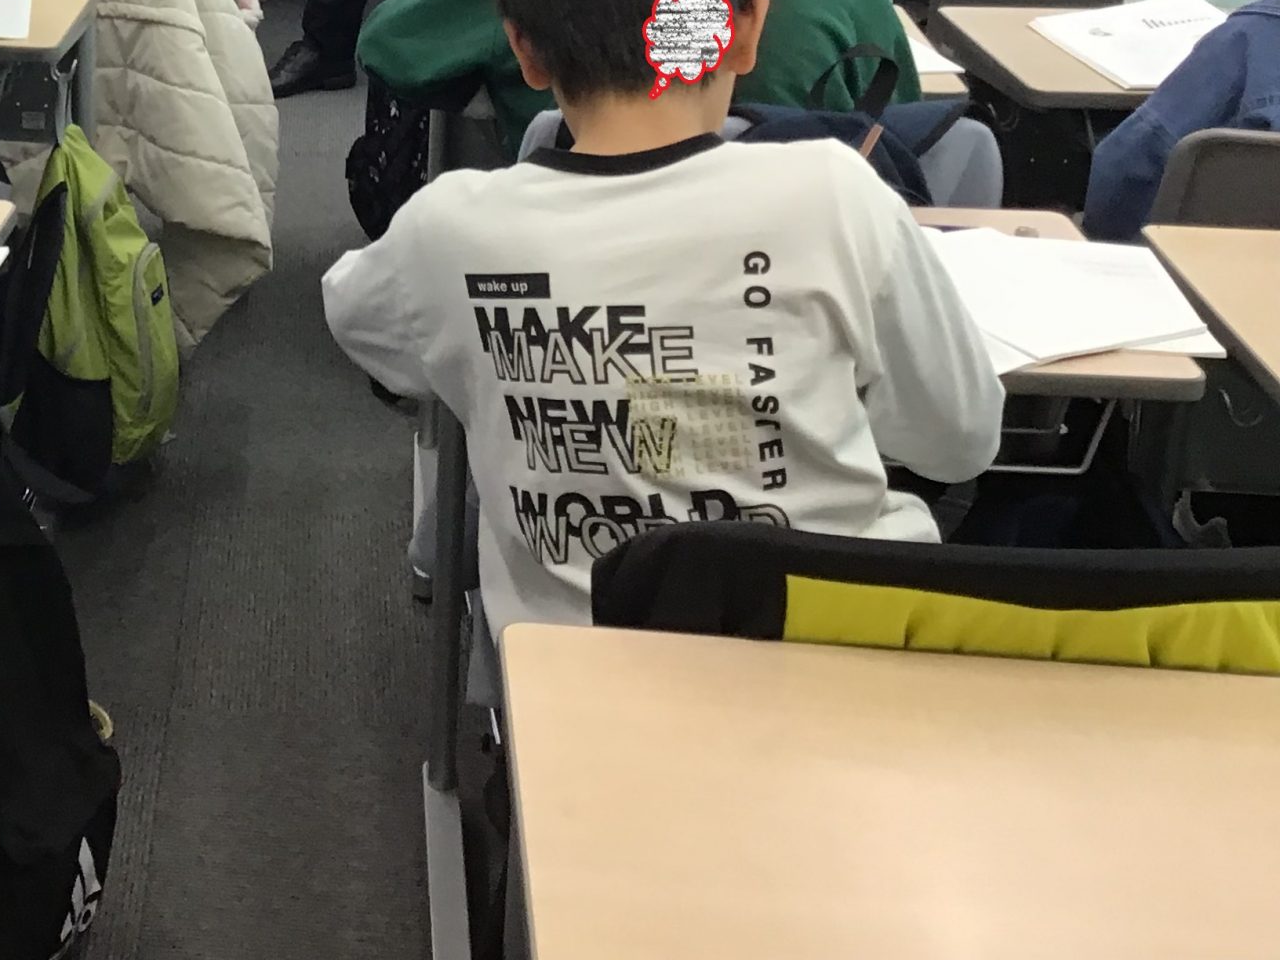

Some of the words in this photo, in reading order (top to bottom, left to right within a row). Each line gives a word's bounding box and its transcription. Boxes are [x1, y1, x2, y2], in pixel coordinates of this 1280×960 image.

[478, 279, 508, 292] wake
[511, 282, 528, 295] up
[743, 251, 771, 309] GO
[474, 305, 651, 360] MAKE
[487, 326, 699, 385] MAKE
[504, 395, 631, 446] NEW
[522, 417, 677, 475] NEW
